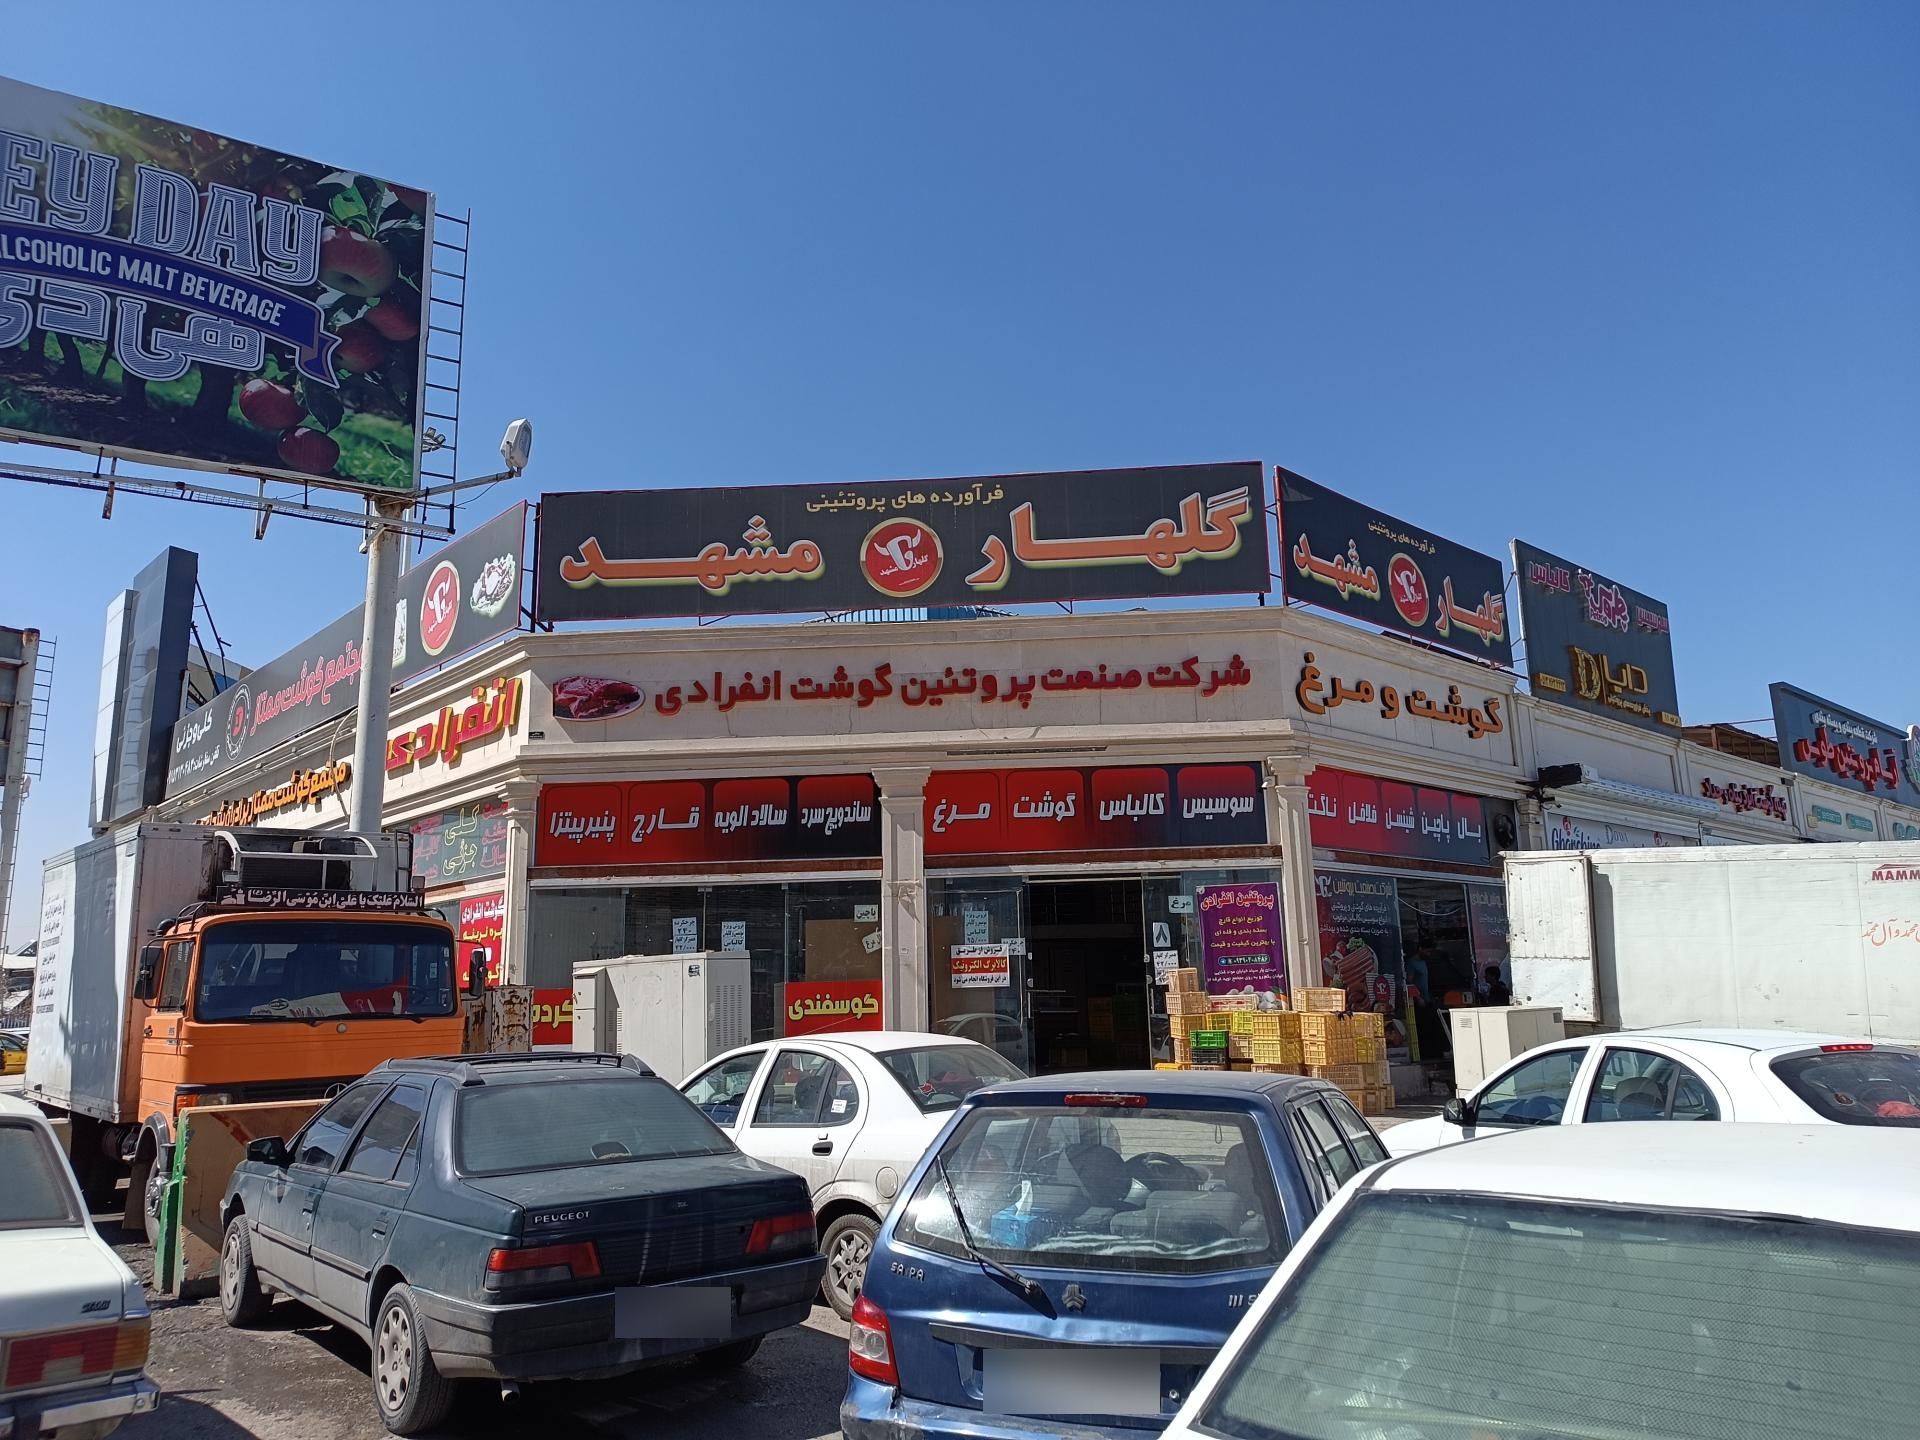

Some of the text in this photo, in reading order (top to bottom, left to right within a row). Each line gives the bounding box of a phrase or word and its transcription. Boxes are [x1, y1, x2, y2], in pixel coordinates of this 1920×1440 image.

[132, 162, 325, 286] DAY
[0, 233, 286, 326] LCOHOLIC MALT BEVERAGE
[806, 483, 1004, 513] فرآورده های پروتئینی
[560, 486, 1249, 592] گلهار مشهد
[1411, 539, 1436, 555] فرآورده
[1293, 532, 1504, 640] گلهار مشهد
[655, 655, 1251, 717] شرکت صنعت پروتئین گوشت انفرادی
[1296, 652, 1504, 740] گوشت و مرغ
[386, 677, 523, 772] انفرادی
[714, 804, 788, 834] سالاد الویه
[801, 801, 872, 835] ساندویچ سرد
[932, 798, 991, 833] مرغ
[1013, 790, 1076, 822] گوشت
[1100, 793, 1164, 821] کالباس
[1182, 795, 1254, 820] سوسیس
[1308, 793, 1337, 818] ناگت
[1348, 801, 1377, 825] فلافل
[549, 810, 616, 844] پنیر پیتزا
[631, 807, 700, 843] قارچ
[1421, 811, 1450, 844] پاچین
[1457, 816, 1481, 843] بال
[462, 902, 484, 925] انفرادی
[1170, 899, 1191, 909] مرغ
[1201, 890, 1275, 911] پروتئین انفرادی
[967, 928, 987, 936] کالباس
[1218, 917, 1231, 926] قارچ
[1231, 916, 1246, 924] انواع
[462, 925, 489, 944] نرینه
[1251, 939, 1271, 947] بهترین
[956, 946, 976, 956] طریق
[984, 946, 1003, 955] فروش
[953, 959, 981, 973] الکترونیک
[788, 994, 879, 1021] گوسفندی
[534, 1210, 591, 1224] PEUGEOT
